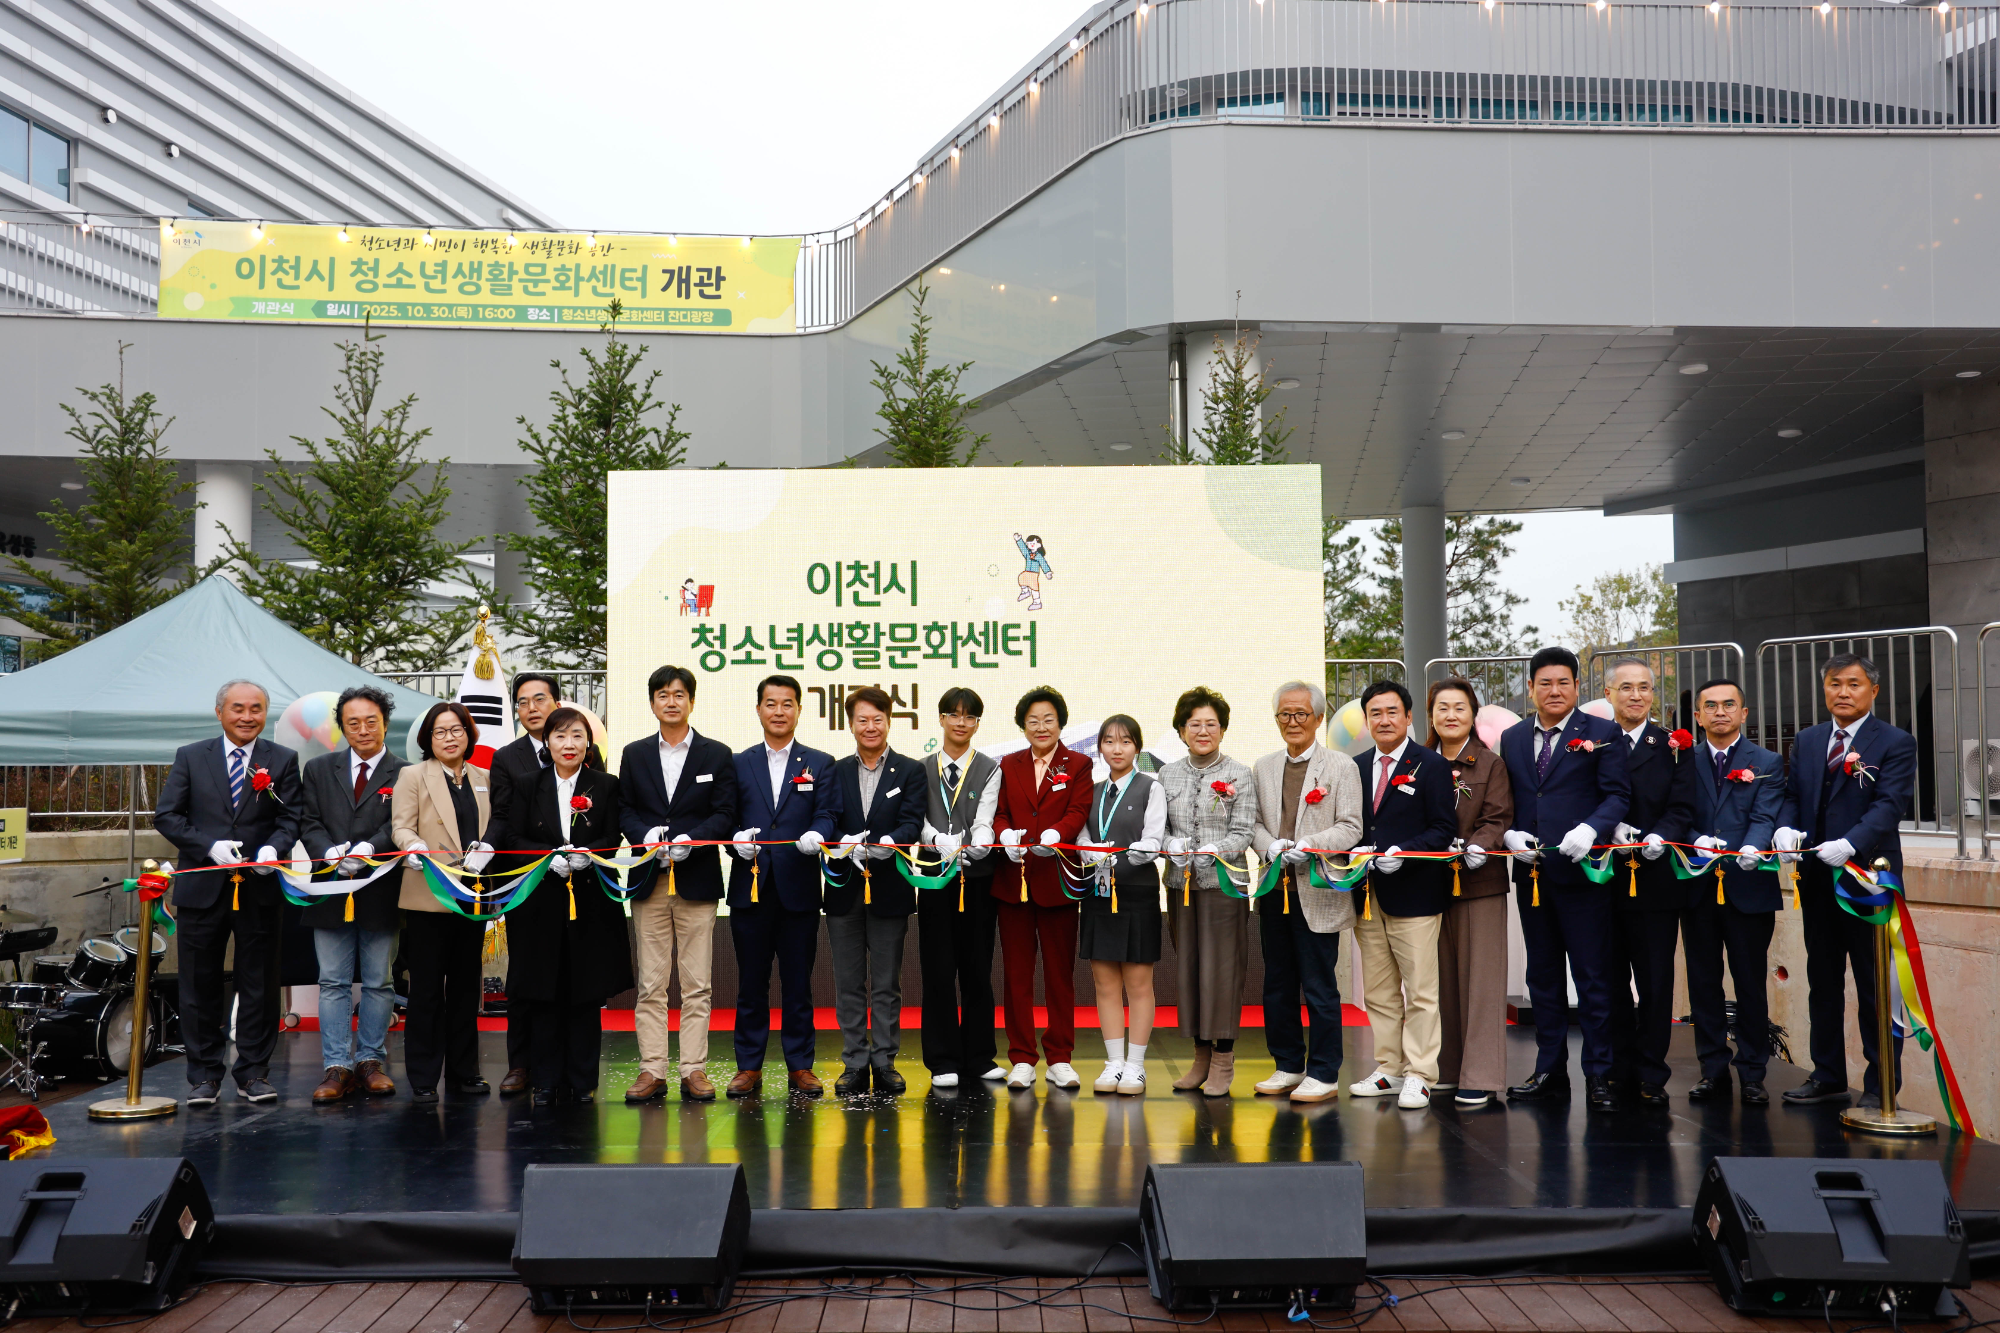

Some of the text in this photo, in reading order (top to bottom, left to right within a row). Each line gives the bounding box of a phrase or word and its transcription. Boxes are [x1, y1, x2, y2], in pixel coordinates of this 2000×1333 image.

[172, 238, 201, 247] 이천시
[360, 235, 419, 251] 청소년과
[472, 237, 517, 255] 행복한
[522, 236, 583, 259] 생활문화
[235, 253, 727, 300] 이천시 청소년생활문화센터 개관
[251, 301, 295, 316] 개관식
[326, 302, 351, 317] 일시
[361, 304, 402, 317] 2025.
[406, 305, 427, 318] 10.
[430, 305, 473, 319] 30.(목)
[477, 306, 516, 320] 16:00
[527, 307, 551, 321] 장소
[668, 310, 714, 323] 잔디광장
[806, 560, 918, 607] 이천시
[691, 621, 1037, 672] 청소년생활문화센터
[807, 682, 919, 731] 개식
